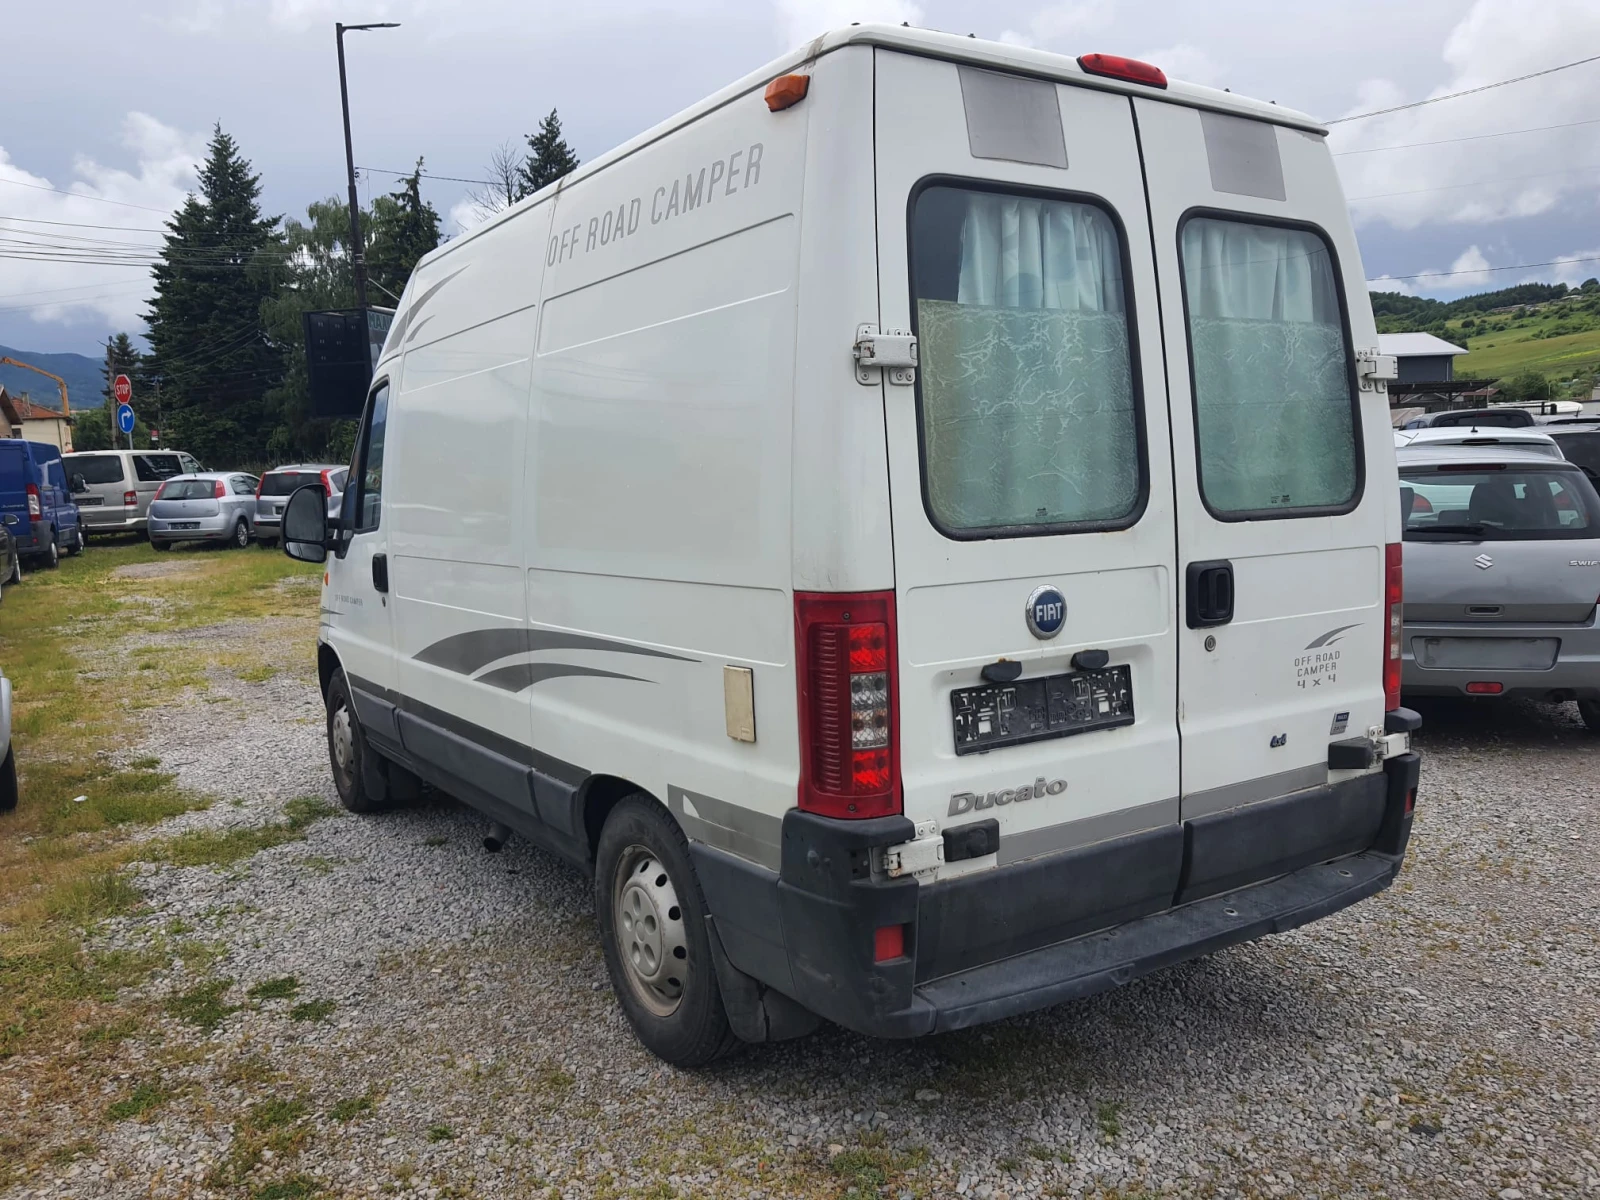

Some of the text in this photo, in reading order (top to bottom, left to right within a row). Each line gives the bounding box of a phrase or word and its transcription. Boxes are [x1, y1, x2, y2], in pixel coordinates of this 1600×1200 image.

[547, 142, 764, 267] OFF ROAD CAMPER
[116, 384, 129, 395] STOP
[1036, 602, 1062, 622] FIAT
[1294, 651, 1340, 667] OFF ROAD
[1297, 662, 1337, 677] CAMPER
[947, 776, 1068, 817] Ducato
